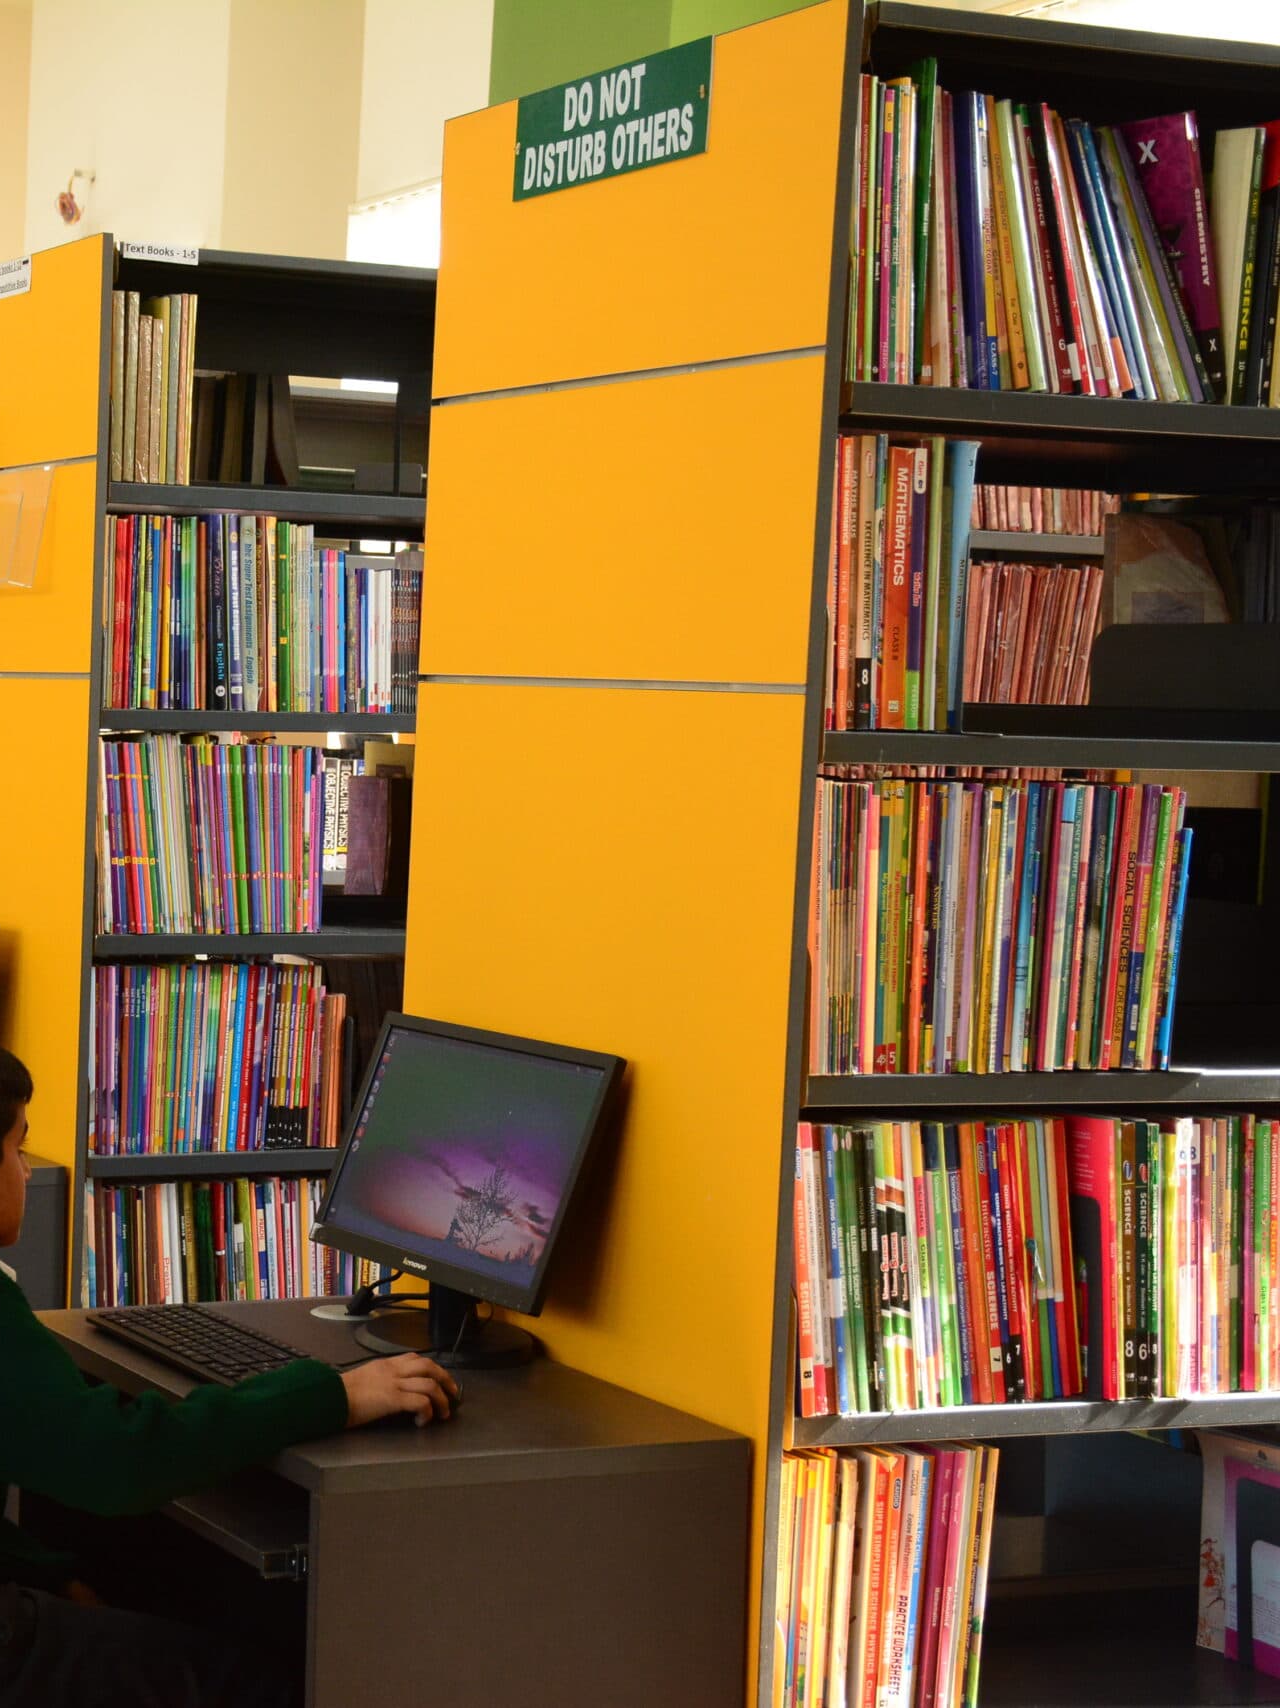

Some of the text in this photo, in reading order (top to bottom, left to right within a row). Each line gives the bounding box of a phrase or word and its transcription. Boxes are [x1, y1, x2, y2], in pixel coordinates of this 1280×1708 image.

[563, 63, 647, 133] DO NOT
[523, 103, 694, 190] DISTURB OTHERS
[1136, 138, 1160, 164] X
[1033, 179, 1046, 227] SCIENCE
[126, 243, 145, 254] Text
[147, 246, 175, 258] Books
[1194, 187, 1218, 353] CHEMISTRY X
[1237, 260, 1255, 370] SCIENCE 10
[990, 341, 999, 377] CLASS-7
[841, 489, 851, 545] MATHEMATICS
[864, 519, 873, 569] EXCELLENCE
[891, 467, 909, 651] MATHEMATICS CLASS
[243, 558, 253, 582] Super
[231, 609, 241, 661] Assignments
[243, 599, 254, 649] Assignments
[861, 579, 872, 641] MATHEMATICS
[215, 641, 225, 680] English
[244, 655, 255, 684] English
[860, 667, 870, 686] 8
[325, 773, 336, 849] OBJECTIVE PHYSICS
[1142, 873, 1151, 905] SOCIAL
[1115, 851, 1137, 1033] SOCIAL SCIENCES FOR CLASS
[1137, 907, 1148, 946] SCIENCE
[1271, 1133, 1280, 1205] Fundamentals
[981, 1199, 993, 1261] Interactive
[1123, 1189, 1132, 1236] SCIENCE
[1139, 1191, 1148, 1239] SCIENCE
[402, 1257, 428, 1271] lenovo
[799, 1281, 810, 1337] SCIENCE
[986, 1270, 999, 1330] SCIENCE
[1124, 1340, 1134, 1358] 8
[1138, 1343, 1148, 1360] 6
[875, 1501, 884, 1531] SUPER
[871, 1534, 882, 1588] SIMPLIFIED
[900, 1534, 912, 1592] Mathematics
[868, 1590, 878, 1631] SCIENCE
[866, 1633, 876, 1674] PHYSICS
[887, 1594, 909, 1696] PRACTICE WORKSHEETS
